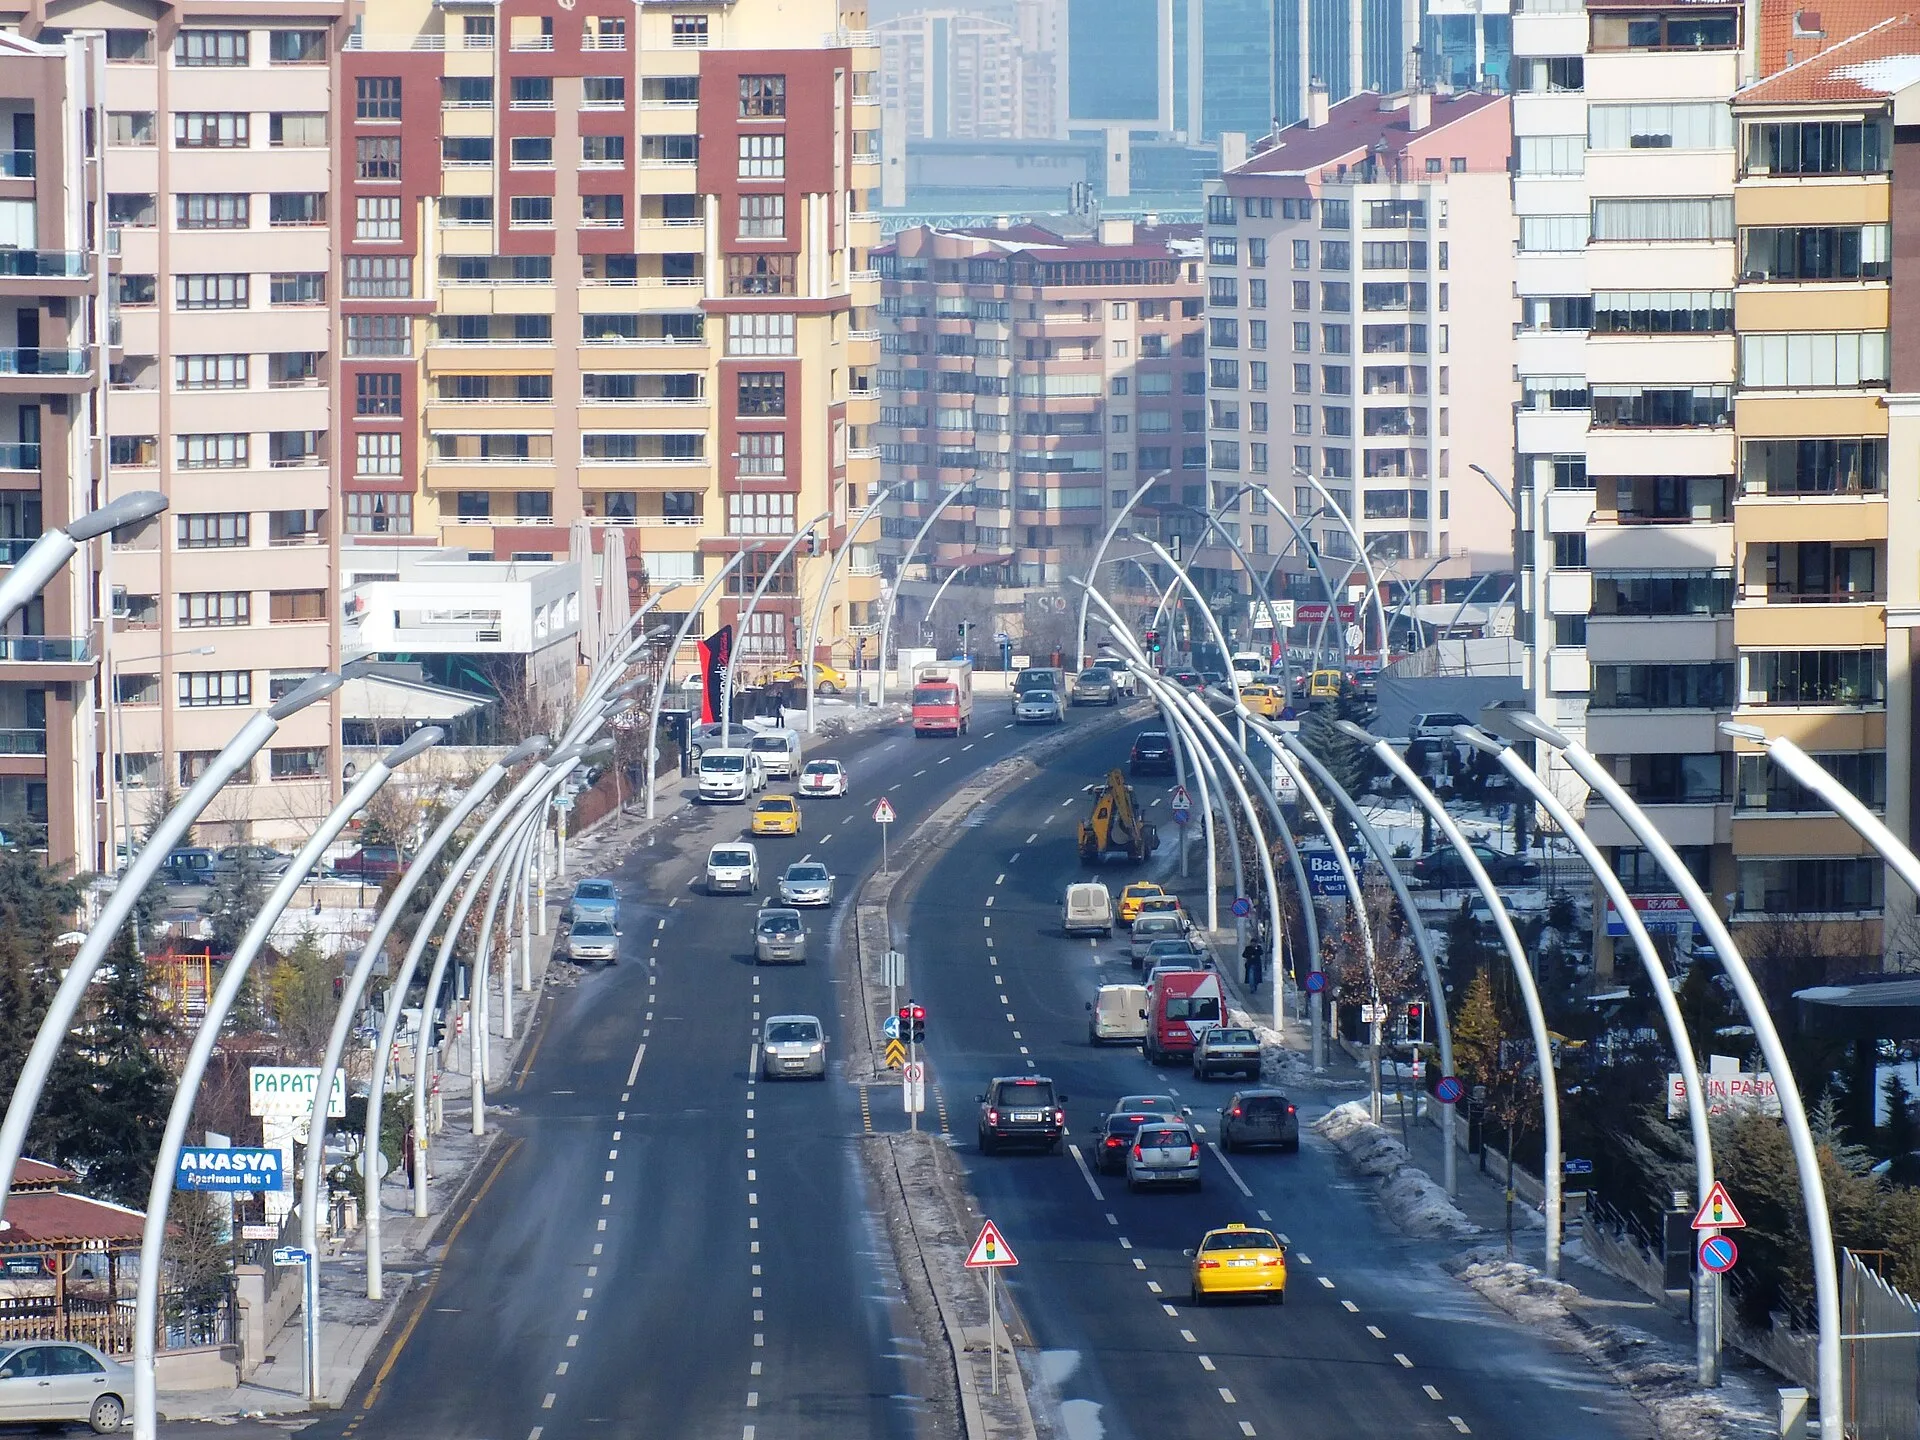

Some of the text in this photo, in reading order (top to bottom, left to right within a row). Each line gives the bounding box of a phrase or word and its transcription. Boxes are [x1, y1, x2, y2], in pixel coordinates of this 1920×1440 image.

[1298, 610, 1353, 618] altunbler
[1311, 857, 1360, 873] Başk
[255, 1073, 340, 1093] PAPATA
[1730, 1080, 1775, 1096] PARK
[306, 1099, 342, 1113] AT.
[180, 1152, 278, 1171] AKASYA
[243, 1173, 262, 1184] No:
[265, 1174, 271, 1184] 1
